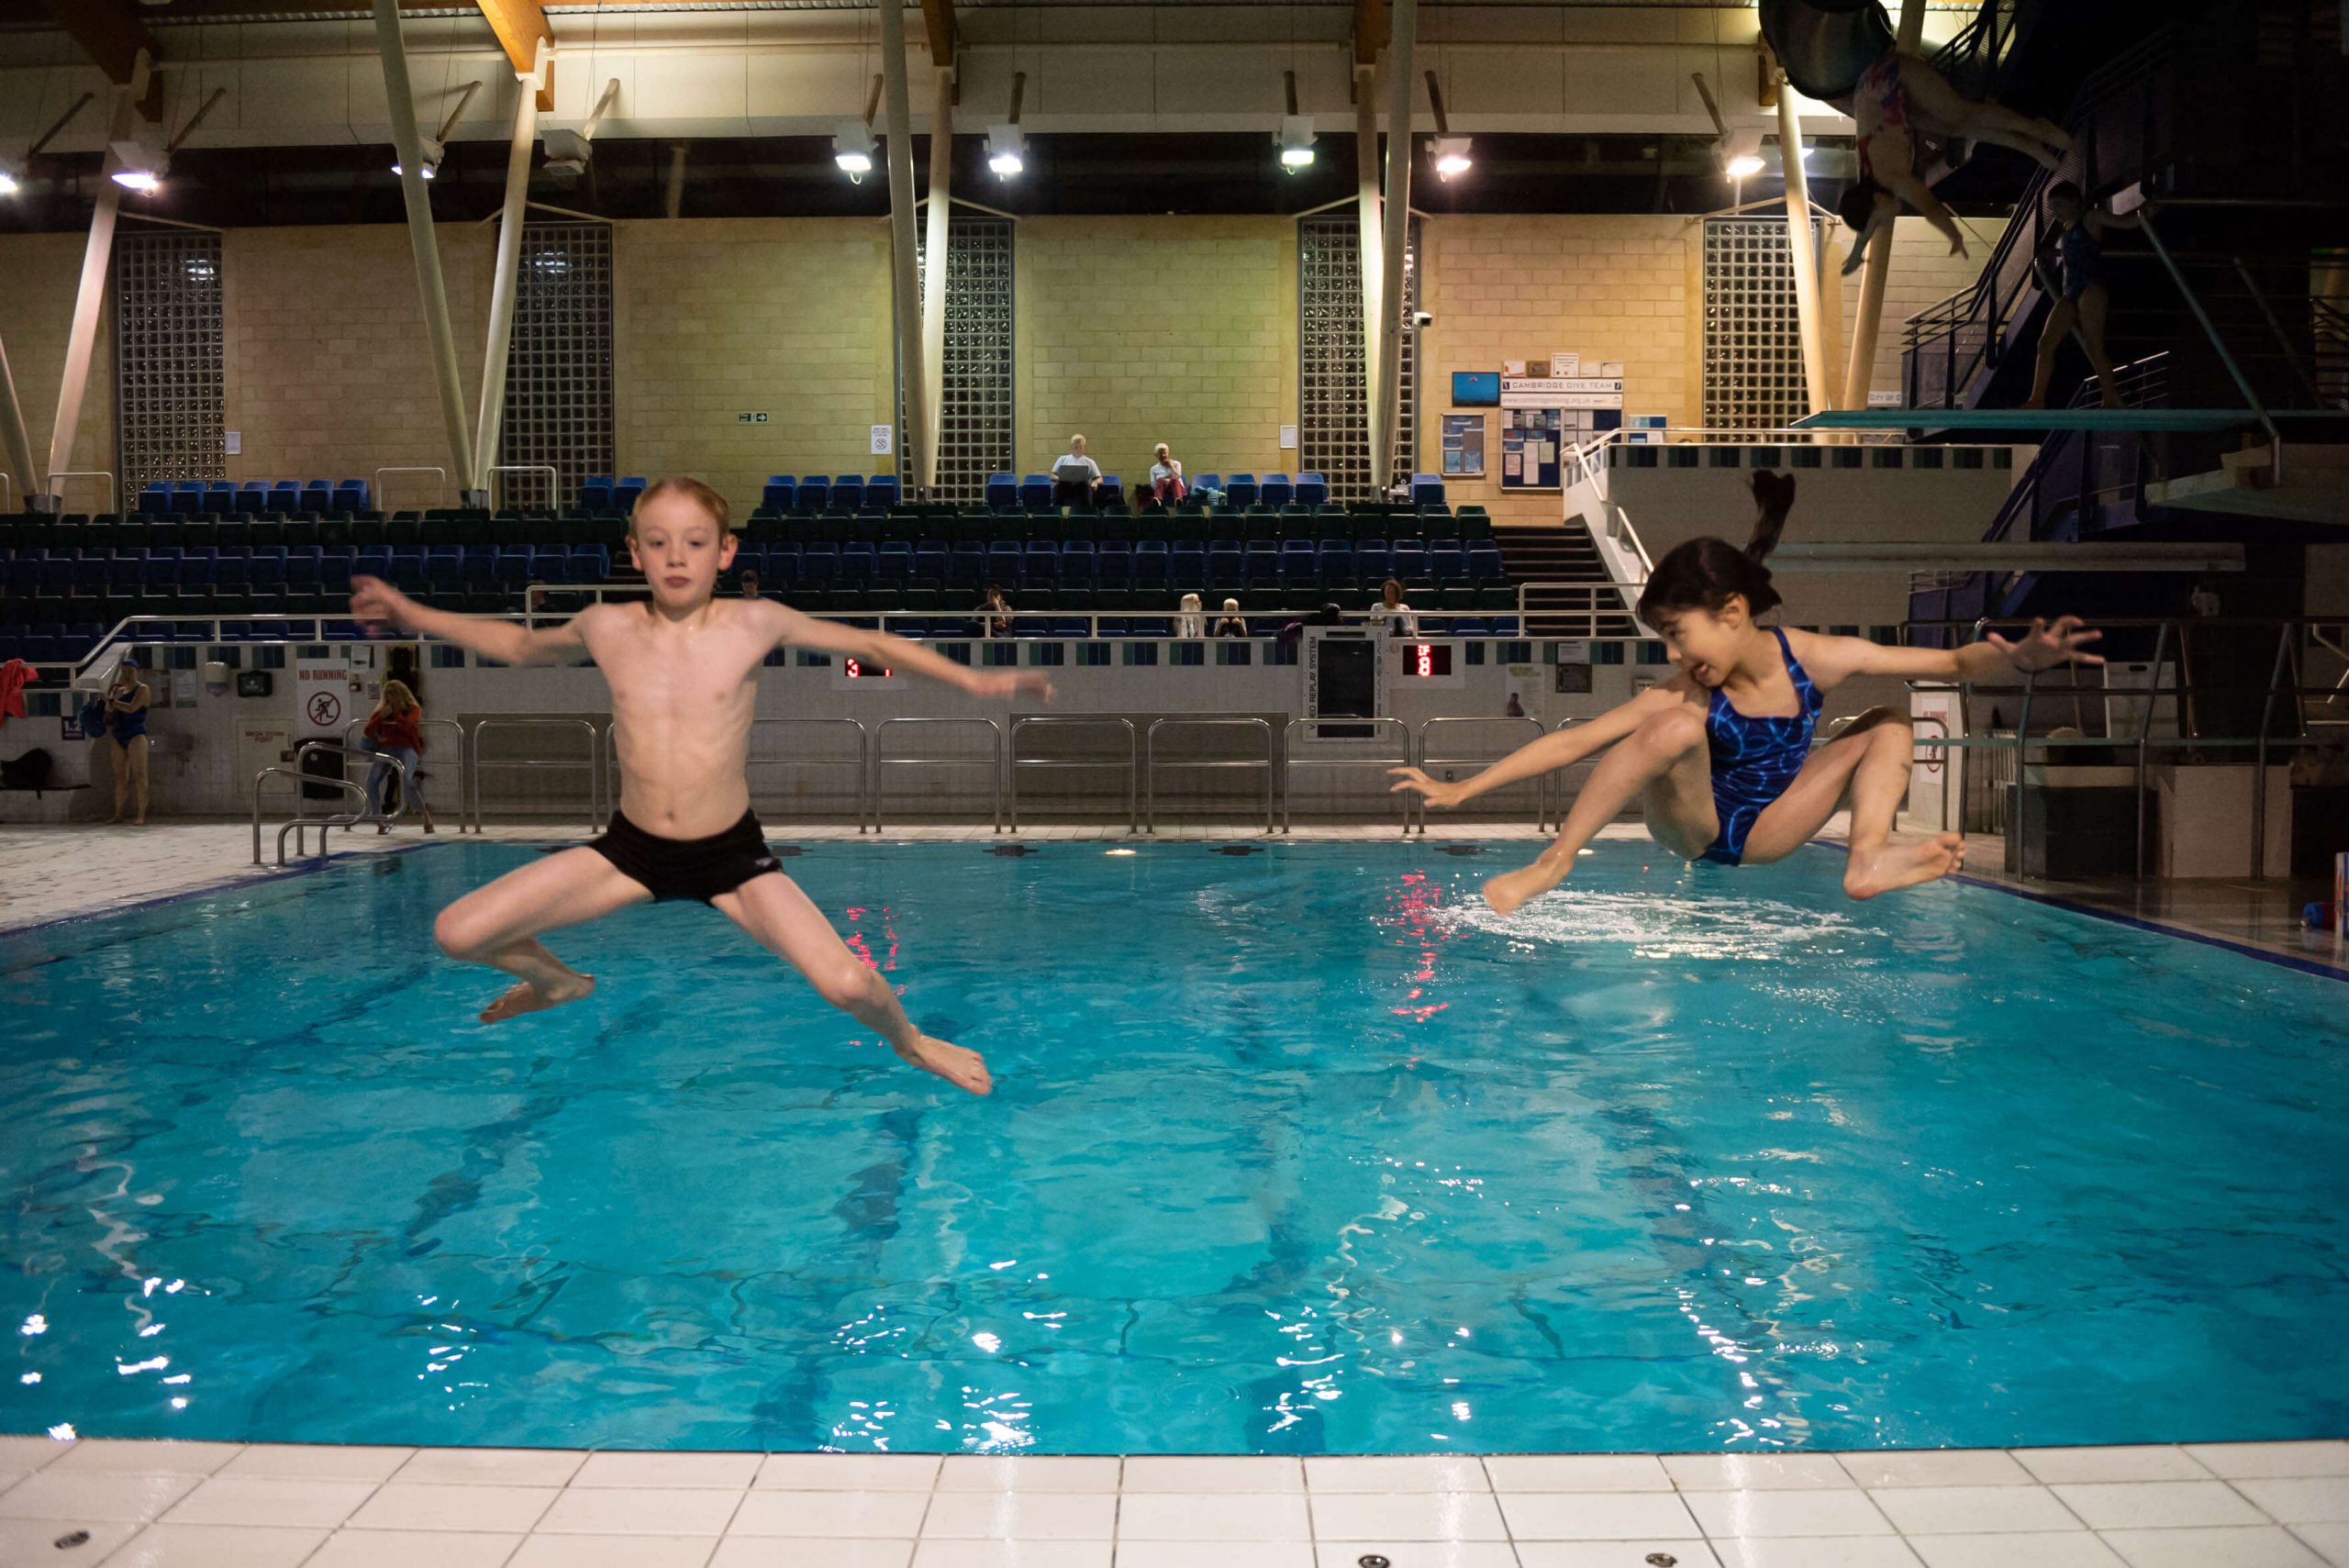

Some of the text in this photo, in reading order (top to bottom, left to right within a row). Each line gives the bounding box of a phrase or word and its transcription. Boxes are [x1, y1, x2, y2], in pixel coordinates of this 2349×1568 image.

[299, 669, 347, 680] NO RUNNING
[847, 658, 859, 677] 3
